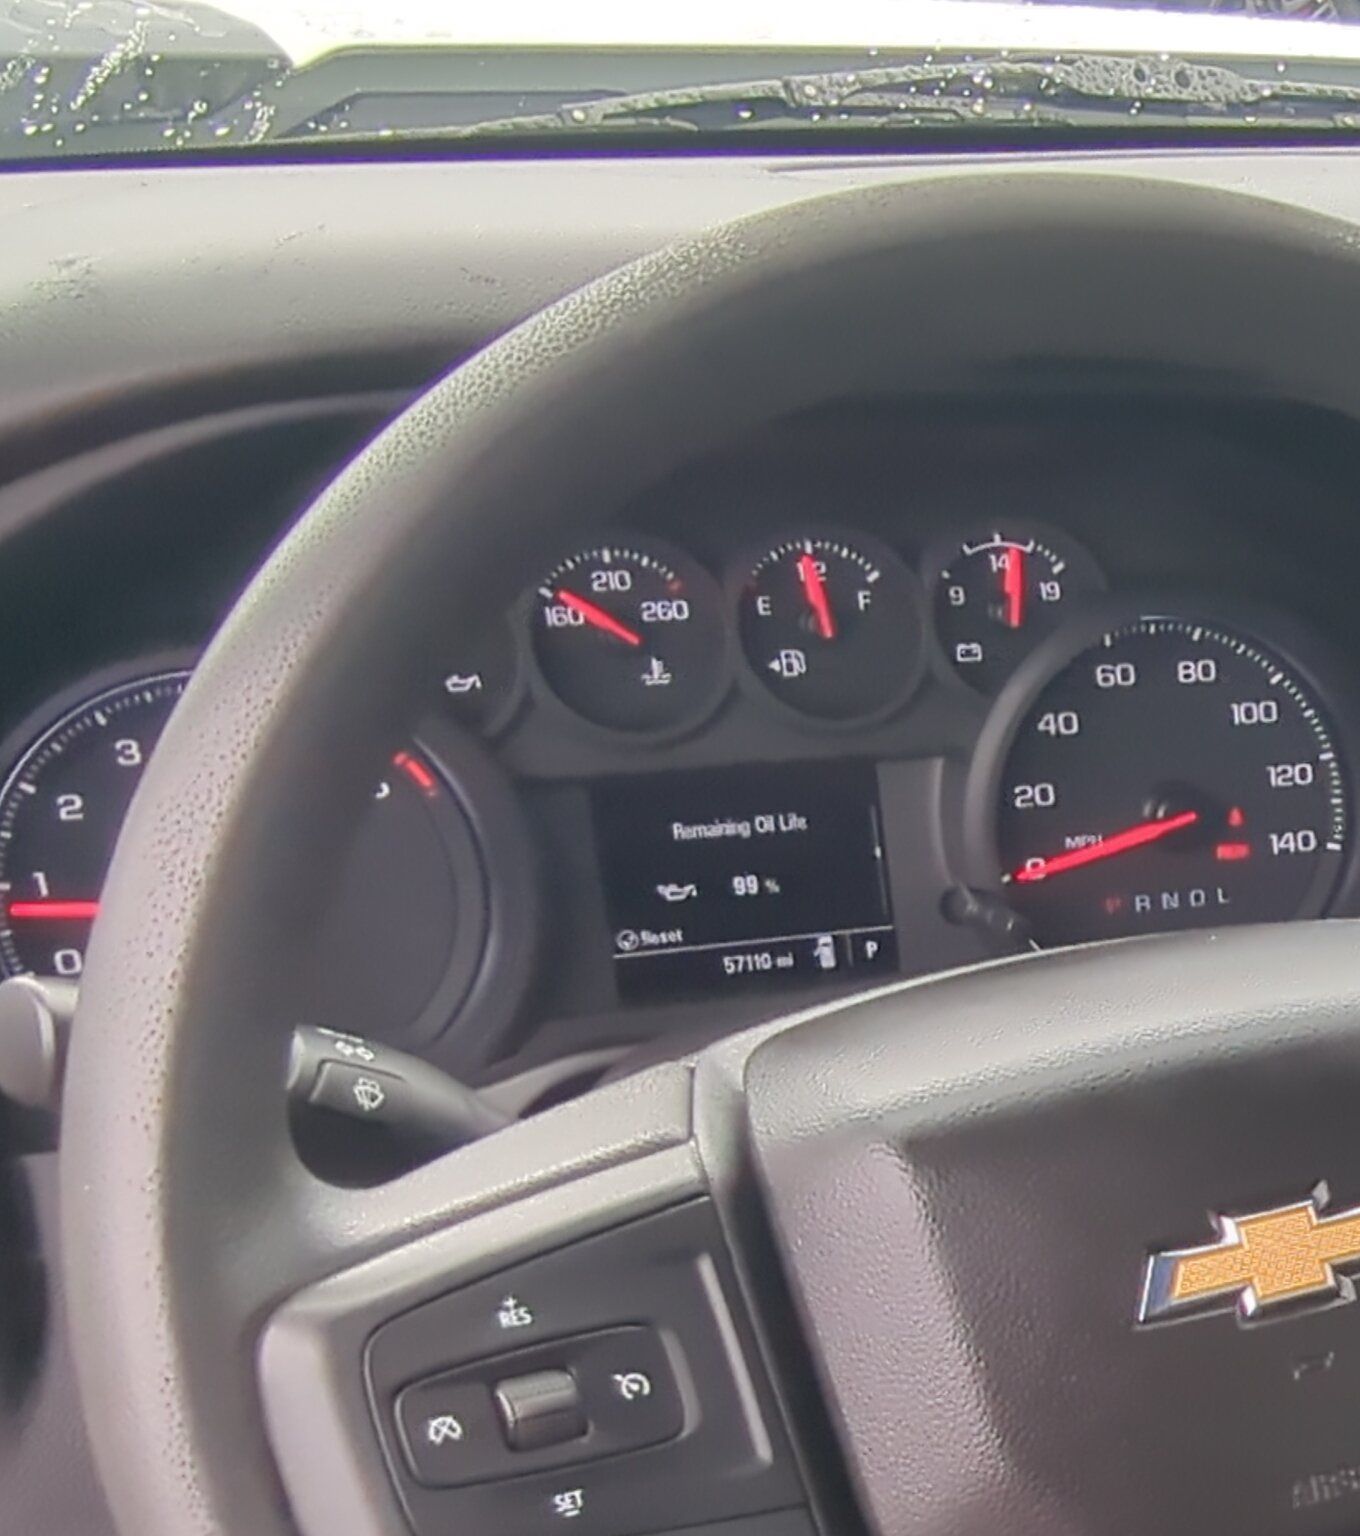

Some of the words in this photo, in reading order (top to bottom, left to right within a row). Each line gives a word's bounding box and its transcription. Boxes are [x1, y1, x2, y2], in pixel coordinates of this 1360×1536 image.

[591, 570, 632, 592] 210
[1039, 581, 1061, 601] 19
[757, 596, 772, 616] E
[858, 591, 872, 611] F
[949, 586, 965, 606] 9
[544, 605, 585, 627] 160
[641, 600, 690, 622] 260
[1096, 663, 1136, 687] 60
[1177, 659, 1216, 684] 80
[1037, 711, 1079, 736] 40
[1230, 700, 1279, 726] 100
[115, 739, 141, 766] 3
[1266, 762, 1314, 788] 120
[1014, 782, 1056, 808] 20
[56, 793, 84, 822] 2
[672, 818, 751, 840] Remaining
[754, 814, 775, 833] Oil
[779, 812, 808, 832] Life
[1270, 829, 1318, 855] 140
[33, 871, 49, 897] 1
[733, 874, 759, 895] 99
[1135, 894, 1151, 912] R
[1162, 891, 1180, 909] N
[1217, 886, 1231, 904] L
[640, 929, 684, 946] Reset
[865, 940, 879, 959] P
[54, 948, 82, 975] 0
[723, 953, 772, 975] 57110
[776, 951, 794, 968] mi
[499, 1306, 533, 1329] RES
[553, 1488, 583, 1513] SET
